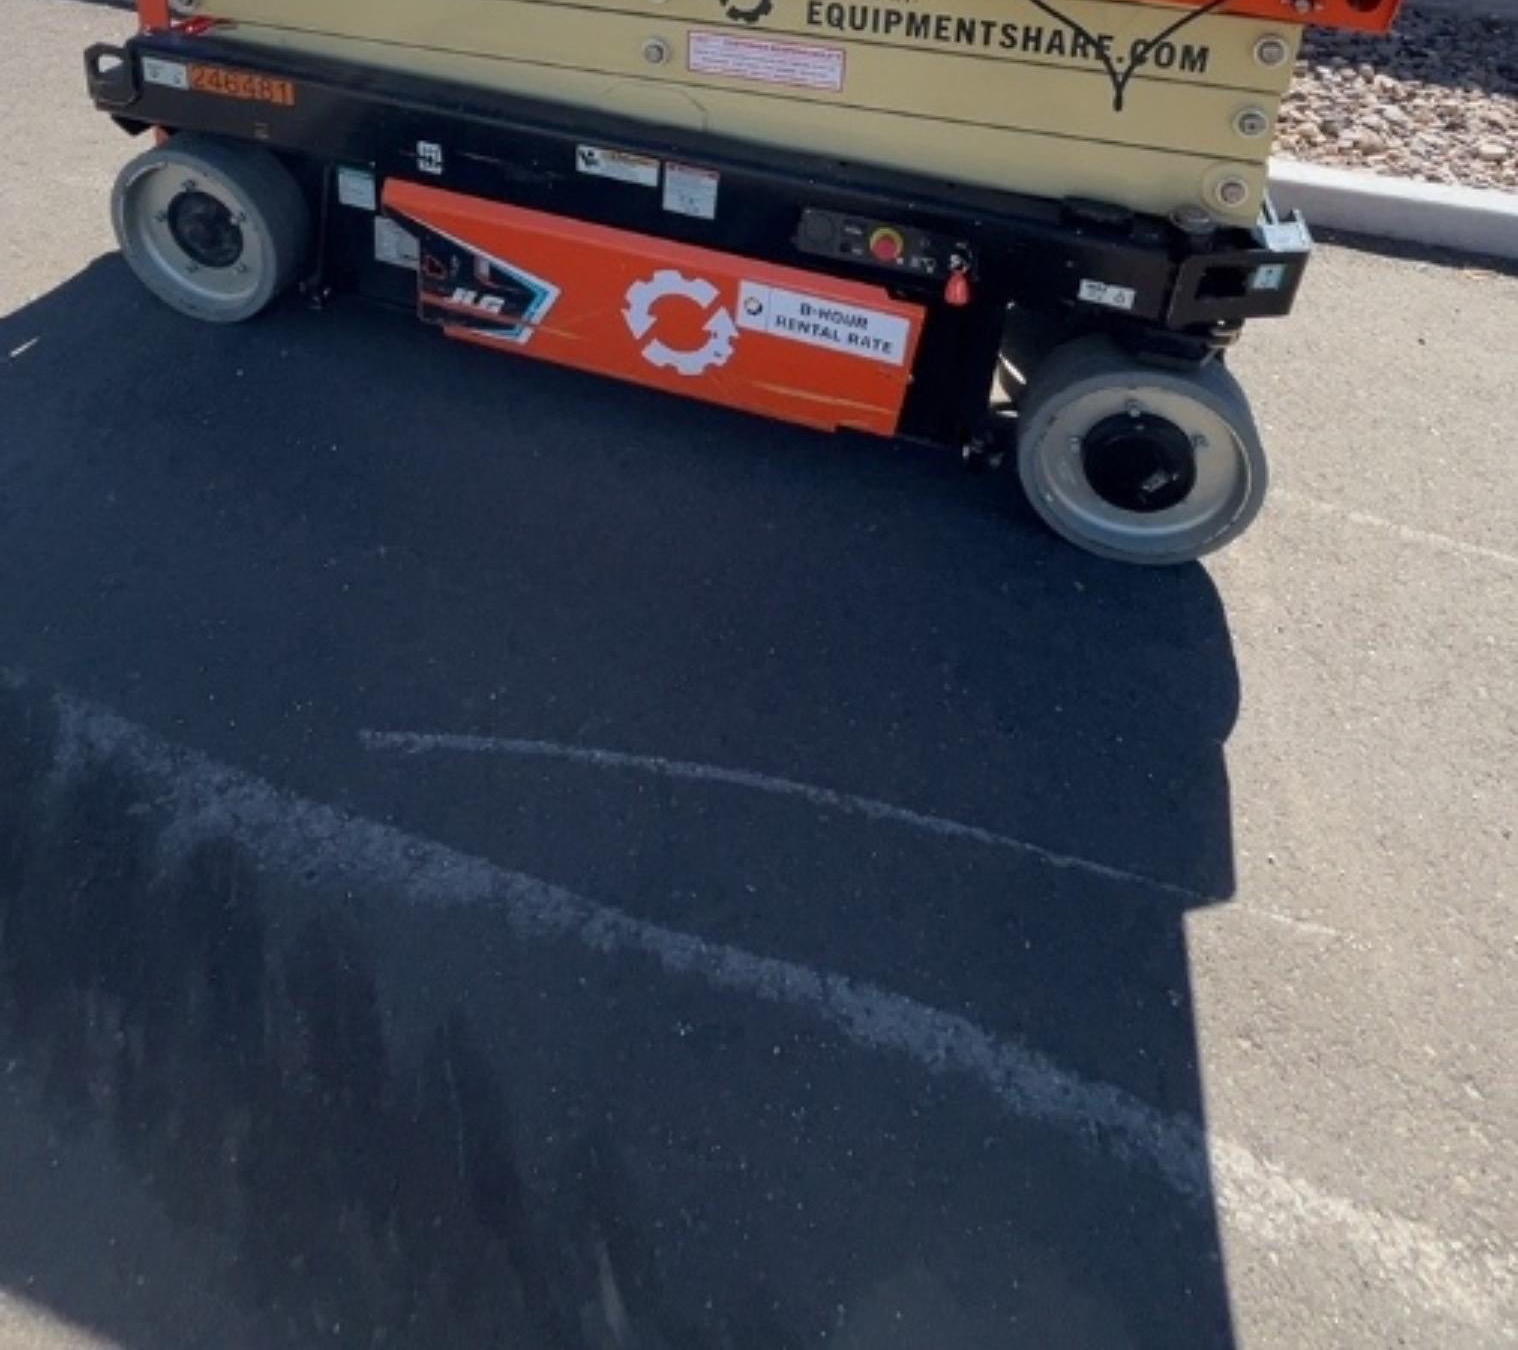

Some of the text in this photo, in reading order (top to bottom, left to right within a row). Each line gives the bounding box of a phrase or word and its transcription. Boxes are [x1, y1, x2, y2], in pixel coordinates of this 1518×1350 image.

[806, 0, 1210, 74] EQUIPMENTSHARE.COM
[192, 62, 292, 102] 246481
[775, 315, 893, 356] RENTAL RATE
[799, 301, 869, 330] 8-HOUR
